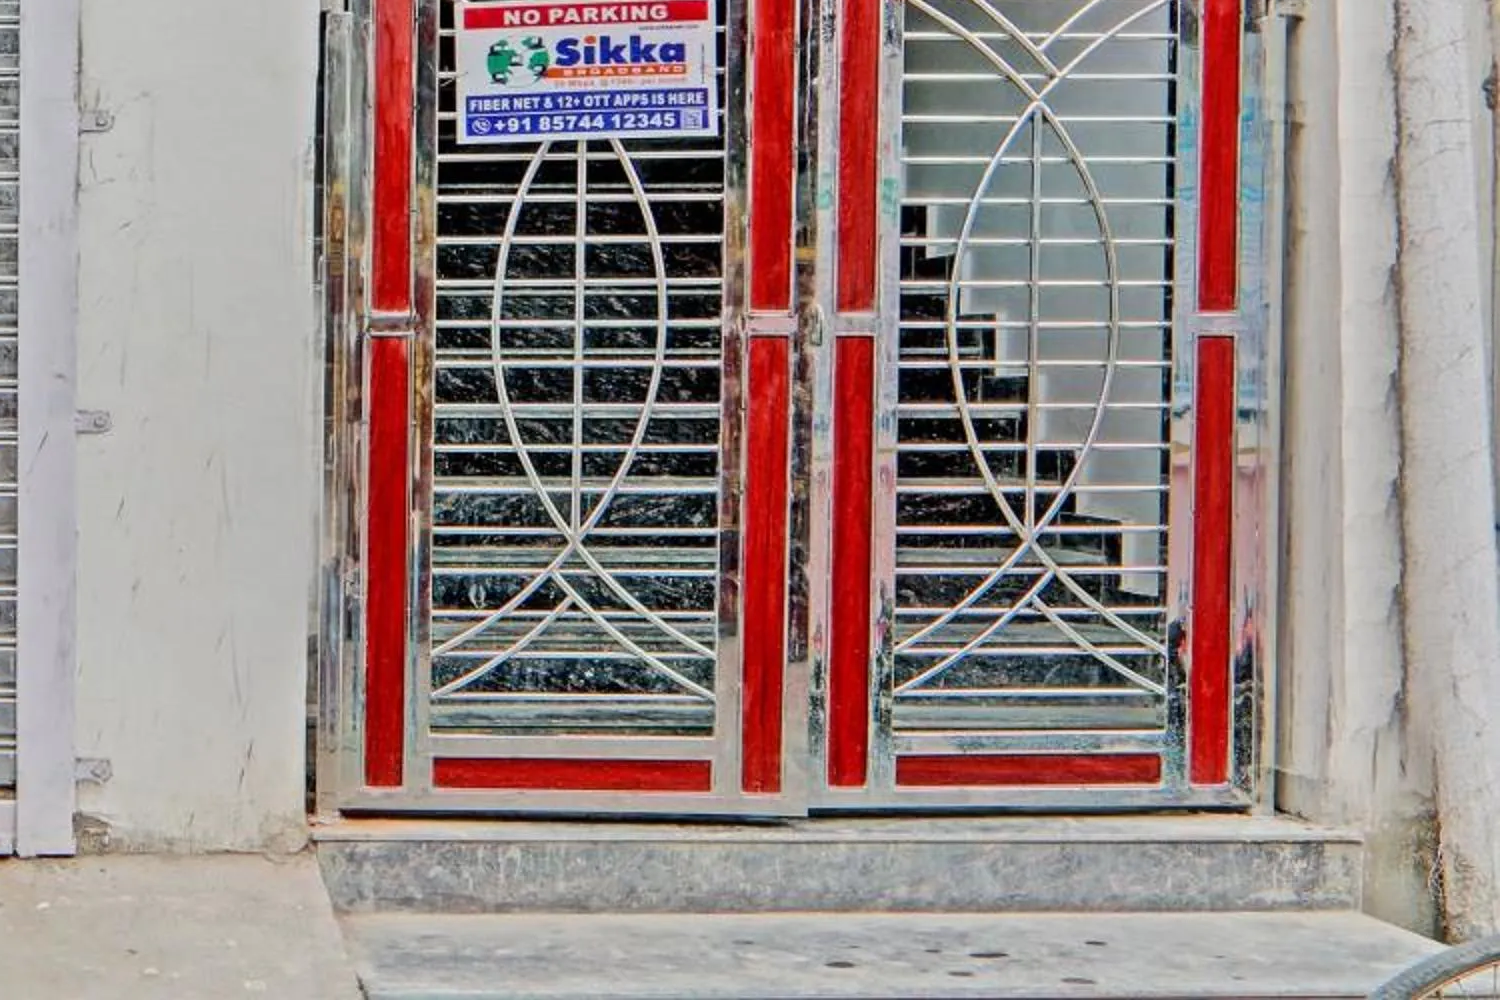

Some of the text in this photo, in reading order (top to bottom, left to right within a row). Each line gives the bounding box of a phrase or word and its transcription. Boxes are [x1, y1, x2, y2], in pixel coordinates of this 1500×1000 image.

[503, 4, 668, 25] NO PARKING
[555, 35, 685, 67] Sikka
[563, 66, 683, 77] BROADBAND
[470, 91, 704, 112] FIBER NET & 12+ OTT APPS IS HERE
[494, 112, 675, 132] +91 85744 12345
